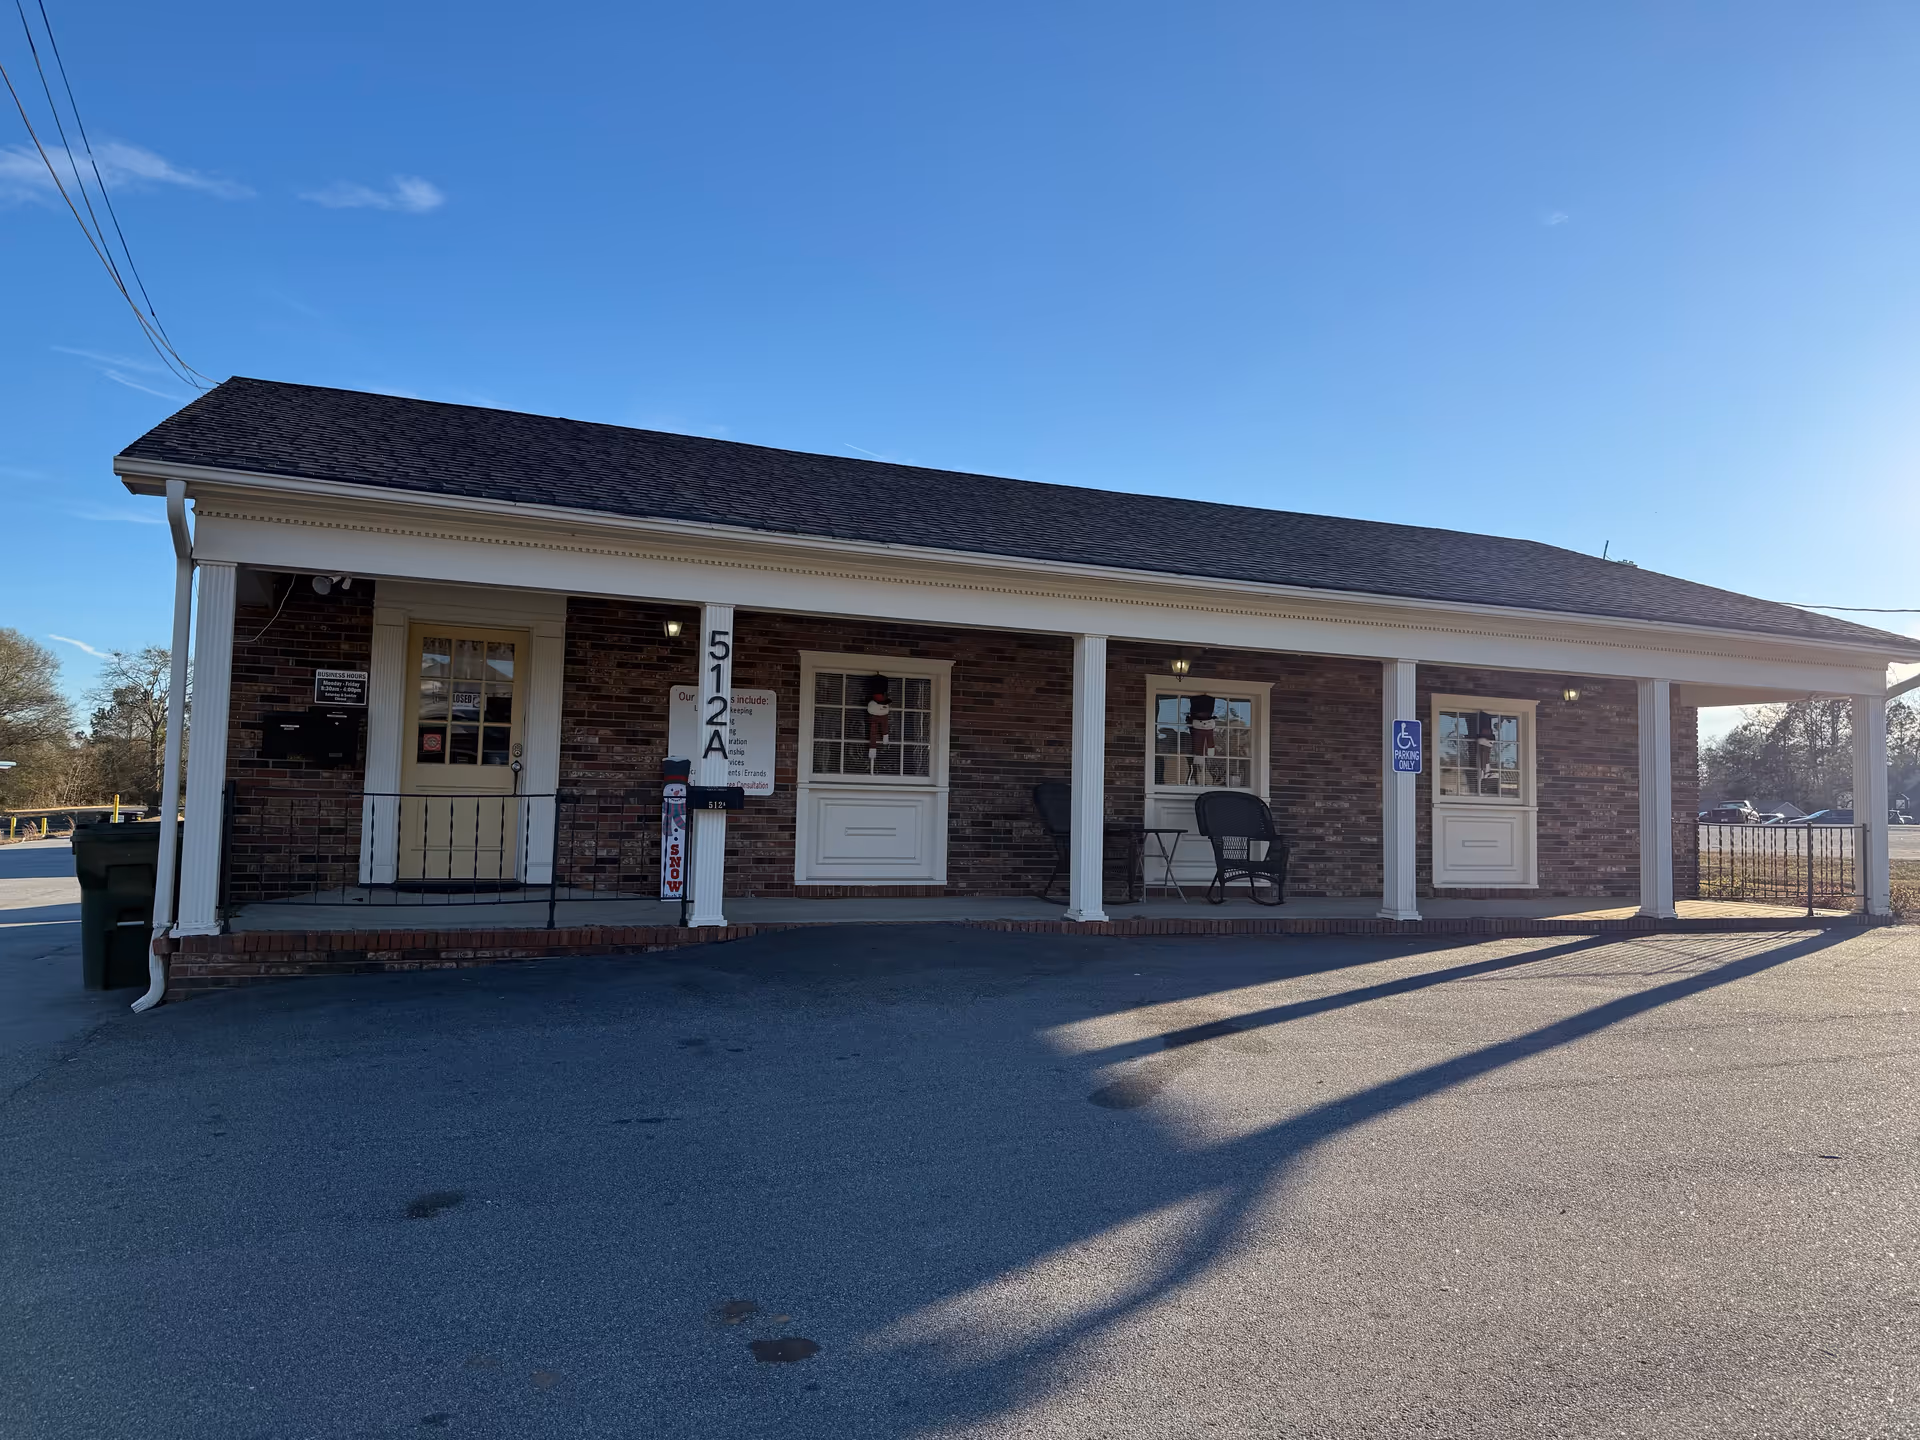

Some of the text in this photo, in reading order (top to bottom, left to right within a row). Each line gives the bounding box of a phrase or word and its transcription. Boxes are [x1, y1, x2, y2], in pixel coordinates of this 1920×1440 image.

[452, 693, 472, 704] LOSED
[678, 691, 696, 701] Our
[736, 695, 769, 705] include:
[702, 630, 730, 760] 512A
[730, 706, 753, 715] keeping
[1394, 750, 1419, 770] PARKING ONLY
[667, 844, 683, 893] SNOW
